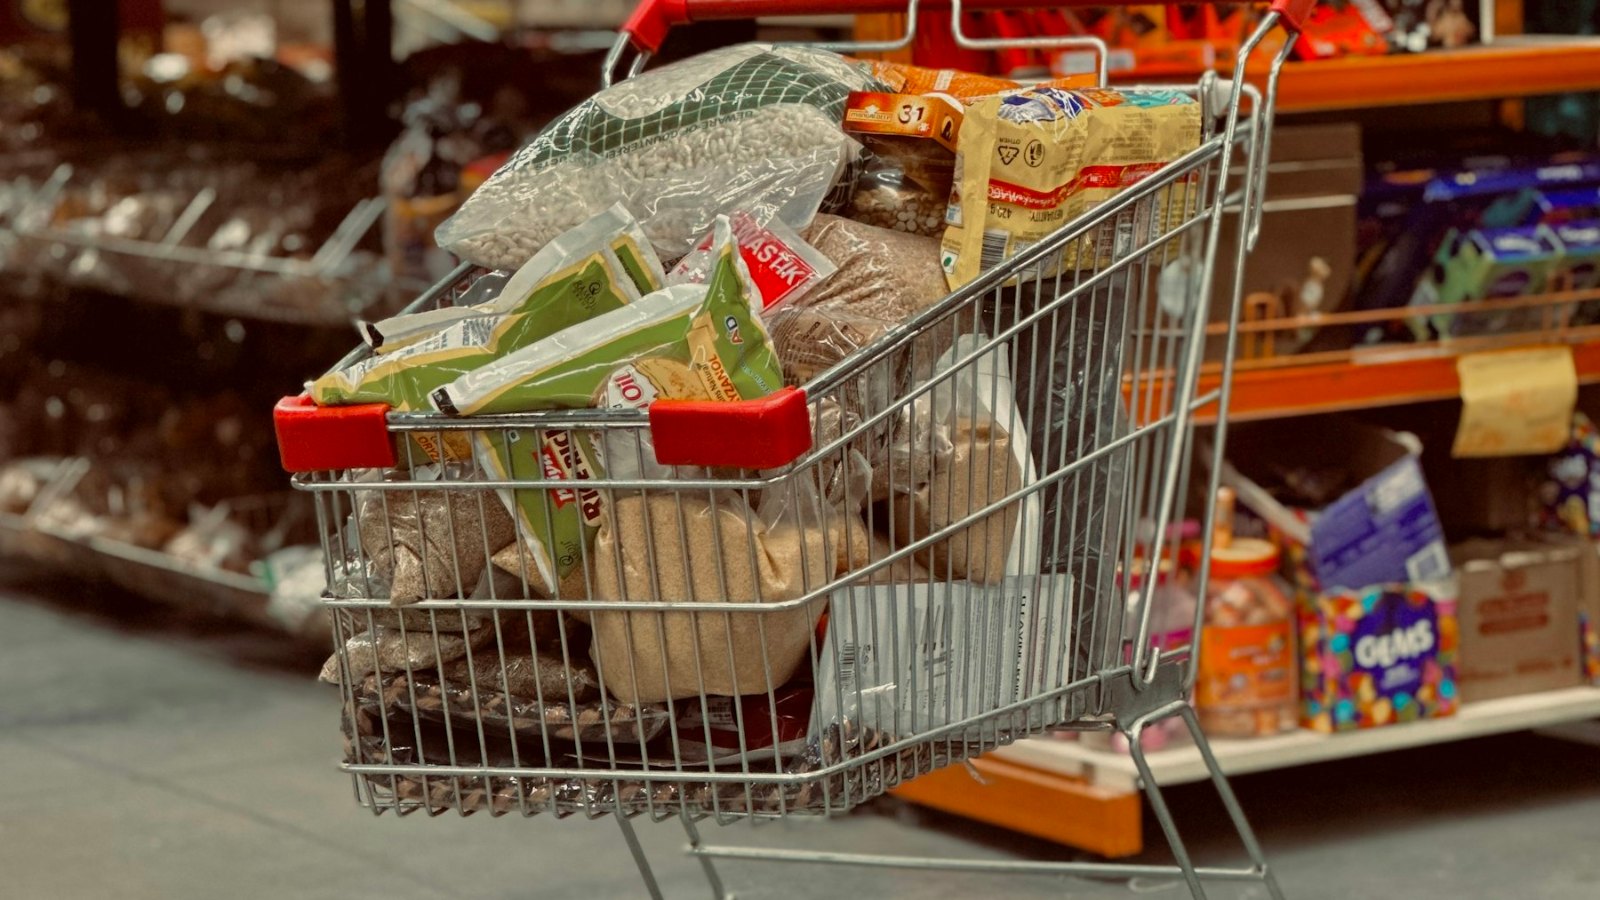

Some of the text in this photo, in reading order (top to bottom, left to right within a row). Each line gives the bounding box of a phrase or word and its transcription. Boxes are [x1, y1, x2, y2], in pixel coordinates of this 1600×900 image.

[606, 129, 680, 159] COUNTERFEI
[615, 372, 642, 401] Oil
[1356, 618, 1435, 669] GEMS
